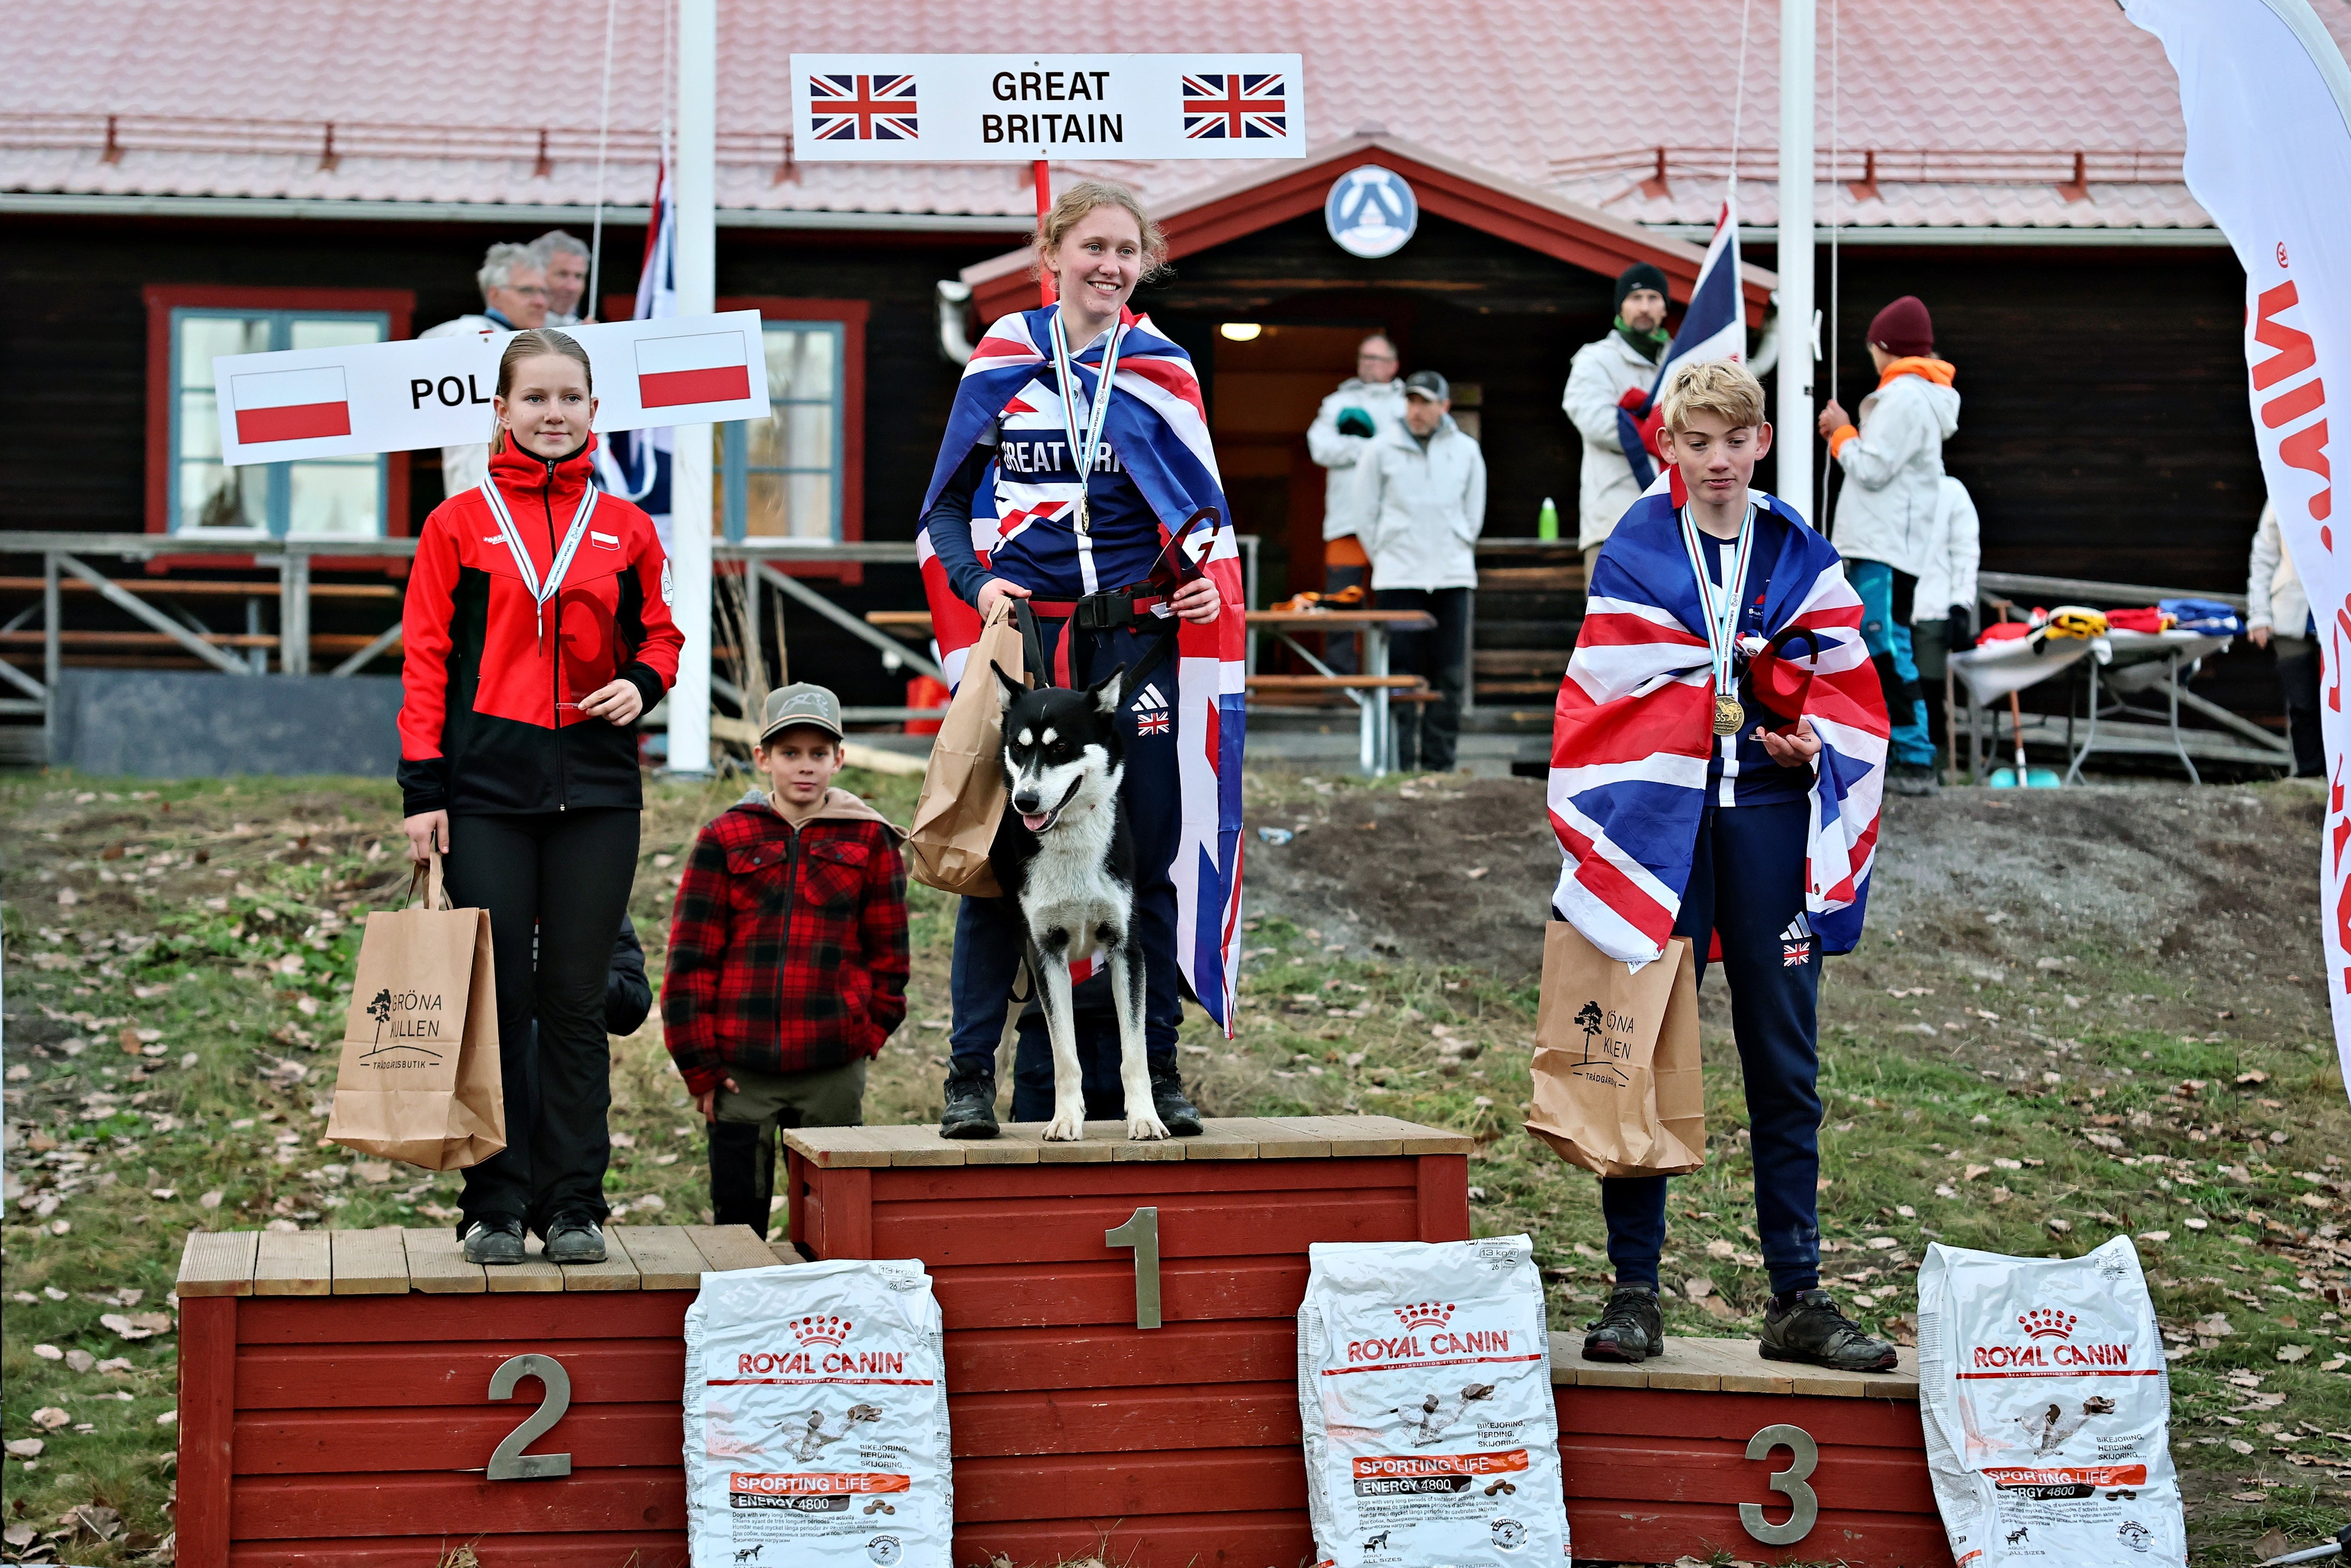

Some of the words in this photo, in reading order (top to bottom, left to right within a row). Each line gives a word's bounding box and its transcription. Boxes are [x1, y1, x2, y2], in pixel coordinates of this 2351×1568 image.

[992, 71, 1110, 101] GREAT
[982, 113, 1123, 144] BRITAIN
[410, 374, 491, 410] POL
[1001, 441, 1065, 473] GREAT
[391, 989, 442, 1012] GRÖNA
[390, 1020, 439, 1038] KULLEN
[1105, 1207, 1161, 1329] 1
[1348, 1336, 1426, 1363] ROYAL
[1974, 1346, 2049, 1368] ROYAL
[738, 1352, 816, 1374] ROYAL
[487, 1353, 571, 1480] 2
[1477, 1420, 1526, 1429] BIKEJORING,
[2096, 1433, 2144, 1443] BIKEJORING,
[860, 1444, 909, 1453] BIKEJORING,
[861, 1452, 898, 1460] HERDING,
[1360, 1459, 1451, 1474] SPORTING
[1454, 1457, 1490, 1472] LIFE
[736, 1477, 830, 1491] SPORTING
[835, 1478, 871, 1491] LIFE
[1739, 1424, 1819, 1545] 3
[1988, 1470, 2071, 1484] SPORTING
[2076, 1470, 2110, 1484] LIFE
[1362, 1480, 1418, 1494] ENERGY
[1421, 1479, 1451, 1491] 4800
[2046, 1486, 2075, 1497] 4800
[738, 1495, 795, 1508] ENERGY
[798, 1498, 829, 1510] 4800
[1494, 1519, 1520, 1529] EXTENDED
[871, 1536, 898, 1545] EXTENDED
[1499, 1540, 1520, 1548] ENERGY
